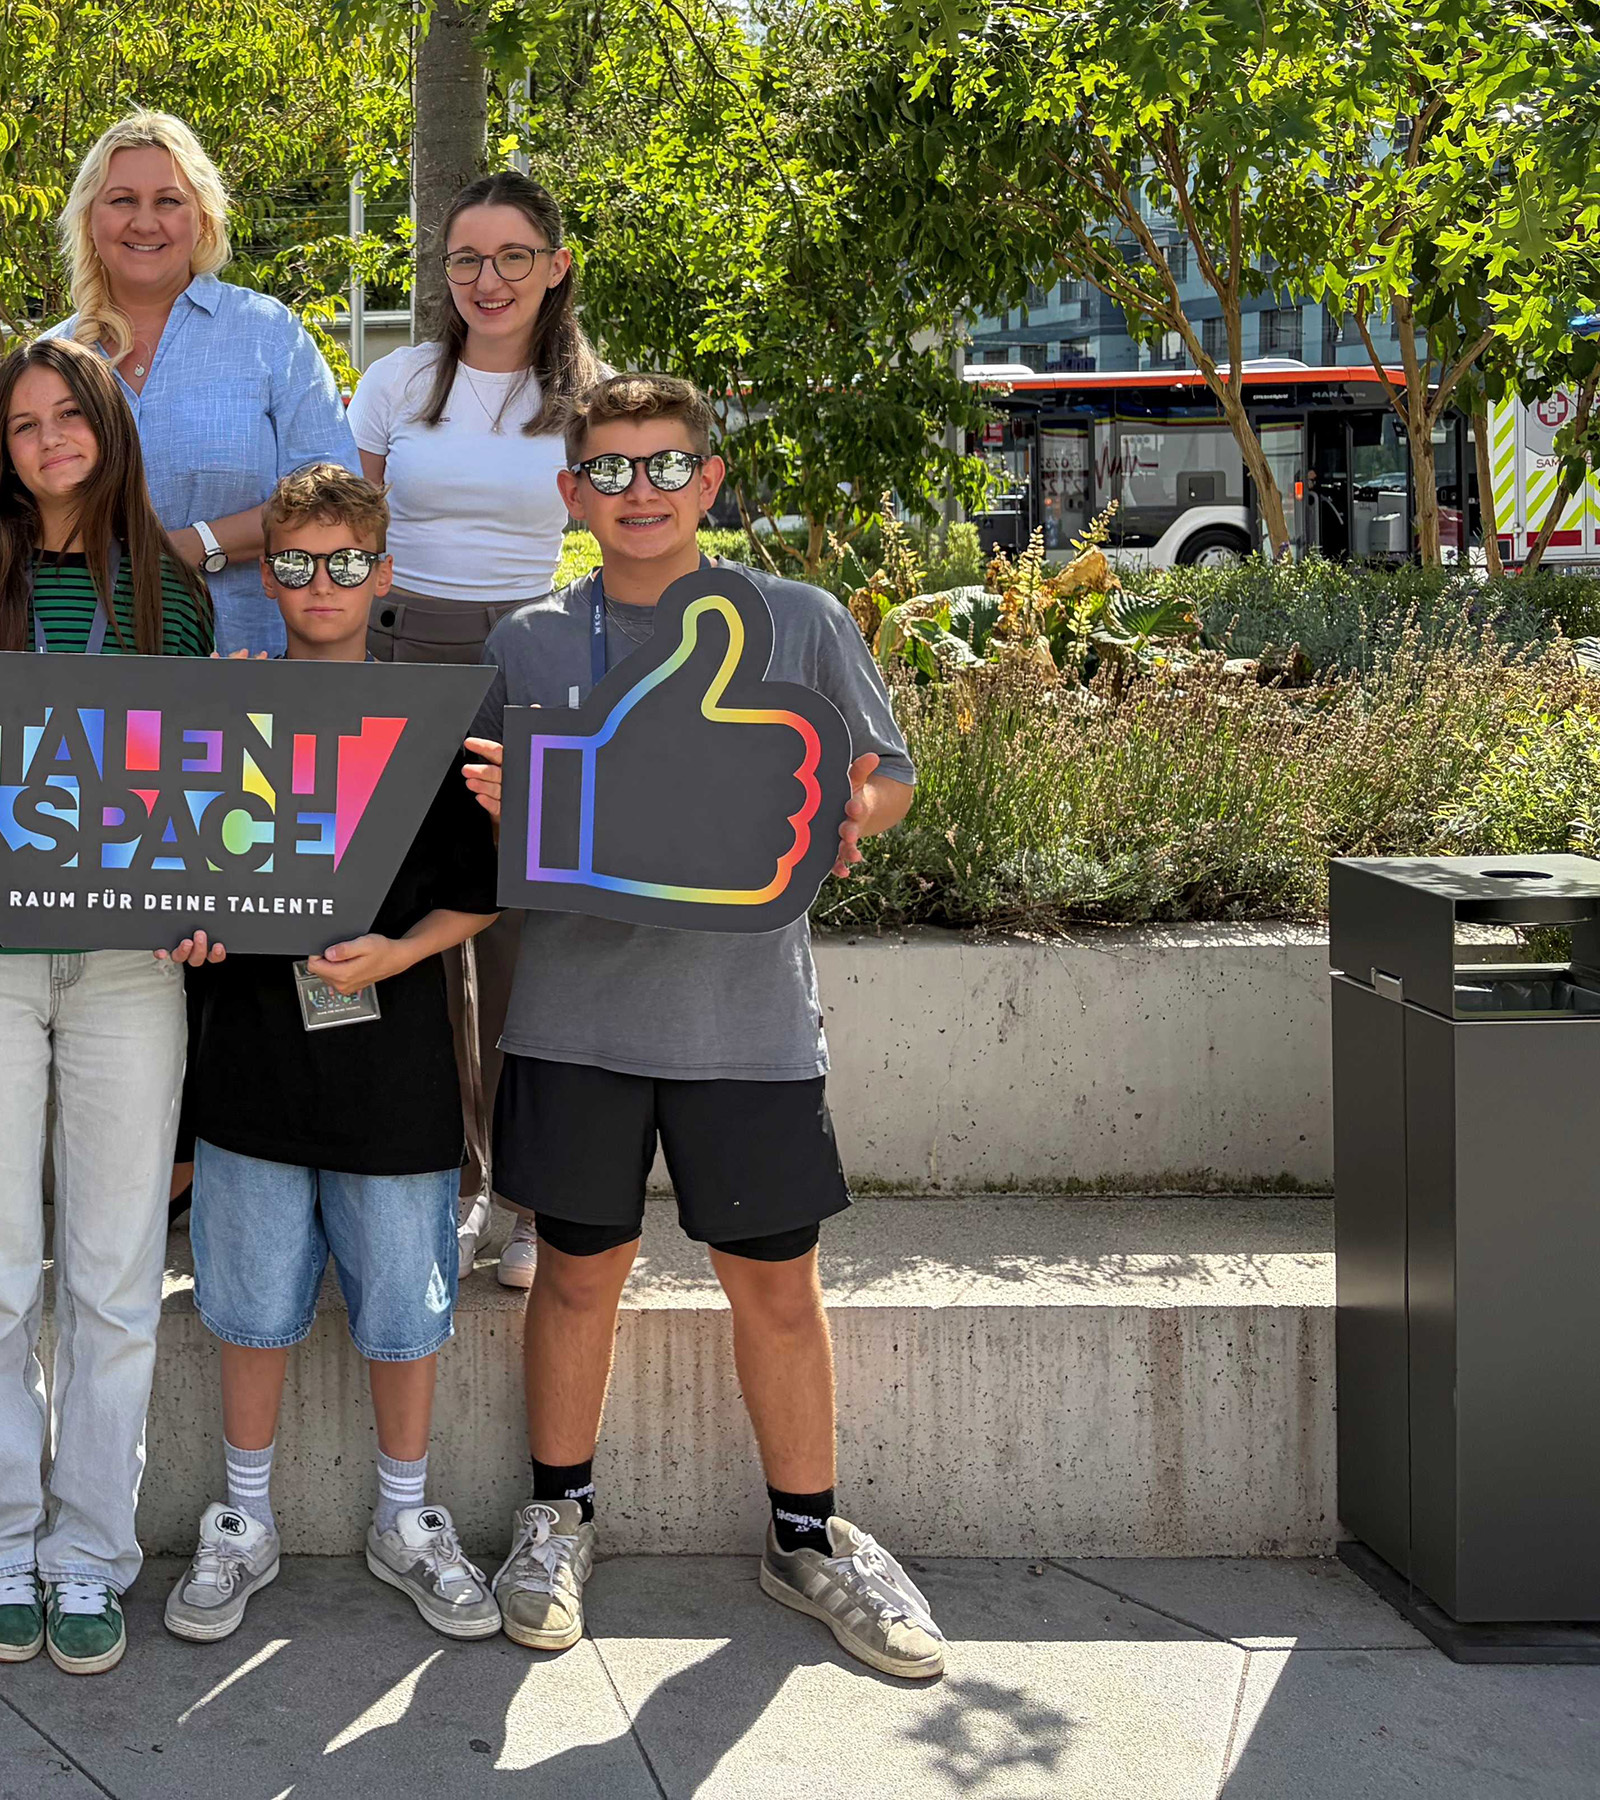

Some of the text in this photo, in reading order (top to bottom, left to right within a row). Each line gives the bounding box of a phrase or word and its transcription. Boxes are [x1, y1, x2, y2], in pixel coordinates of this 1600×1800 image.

[12, 785, 337, 873] SPACE
[9, 889, 334, 915] RAUM FÜR DEINE TALENTE
